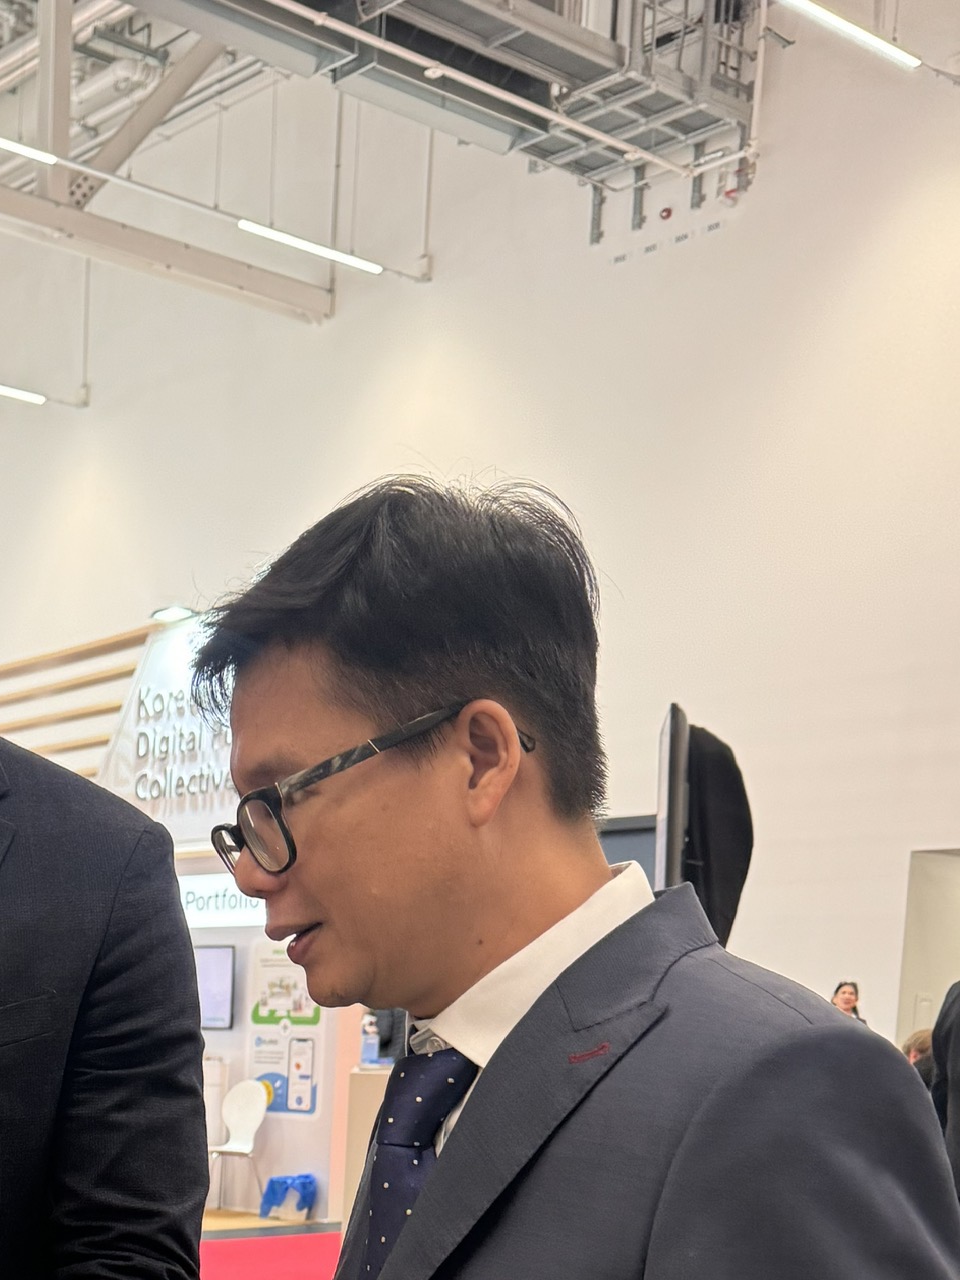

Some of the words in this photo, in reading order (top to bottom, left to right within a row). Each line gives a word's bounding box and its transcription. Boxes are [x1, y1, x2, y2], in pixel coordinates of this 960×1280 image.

[138, 688, 197, 717] Kore
[136, 724, 203, 761] Digital
[185, 888, 260, 912] Portfolio
